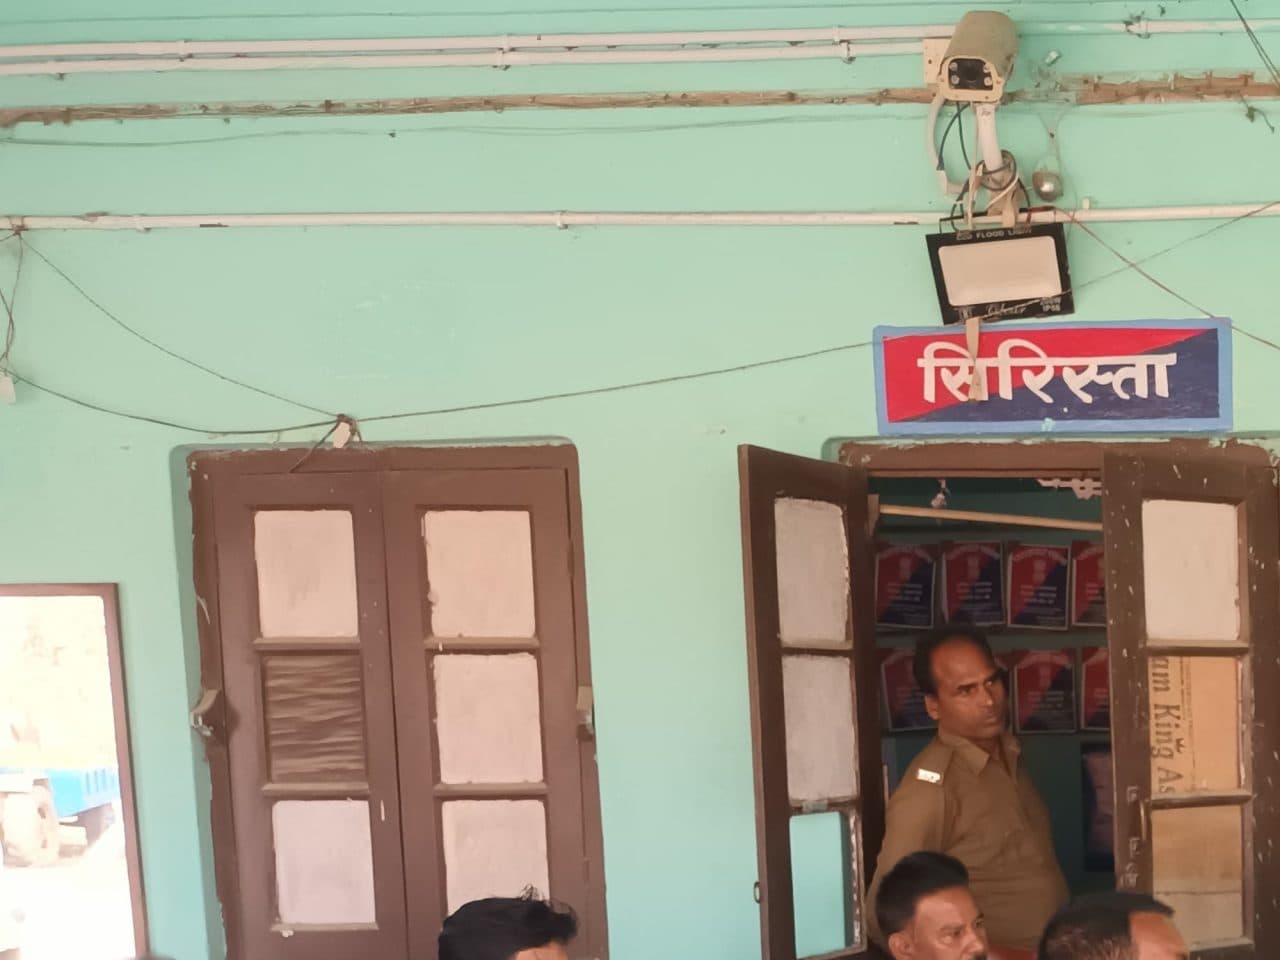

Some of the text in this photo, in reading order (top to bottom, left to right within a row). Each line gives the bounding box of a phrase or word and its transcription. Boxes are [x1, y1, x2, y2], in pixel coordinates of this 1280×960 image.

[976, 230, 1005, 239] FLOOD
[917, 338, 1178, 404] सिरिस्ता
[1151, 703, 1182, 760] King
